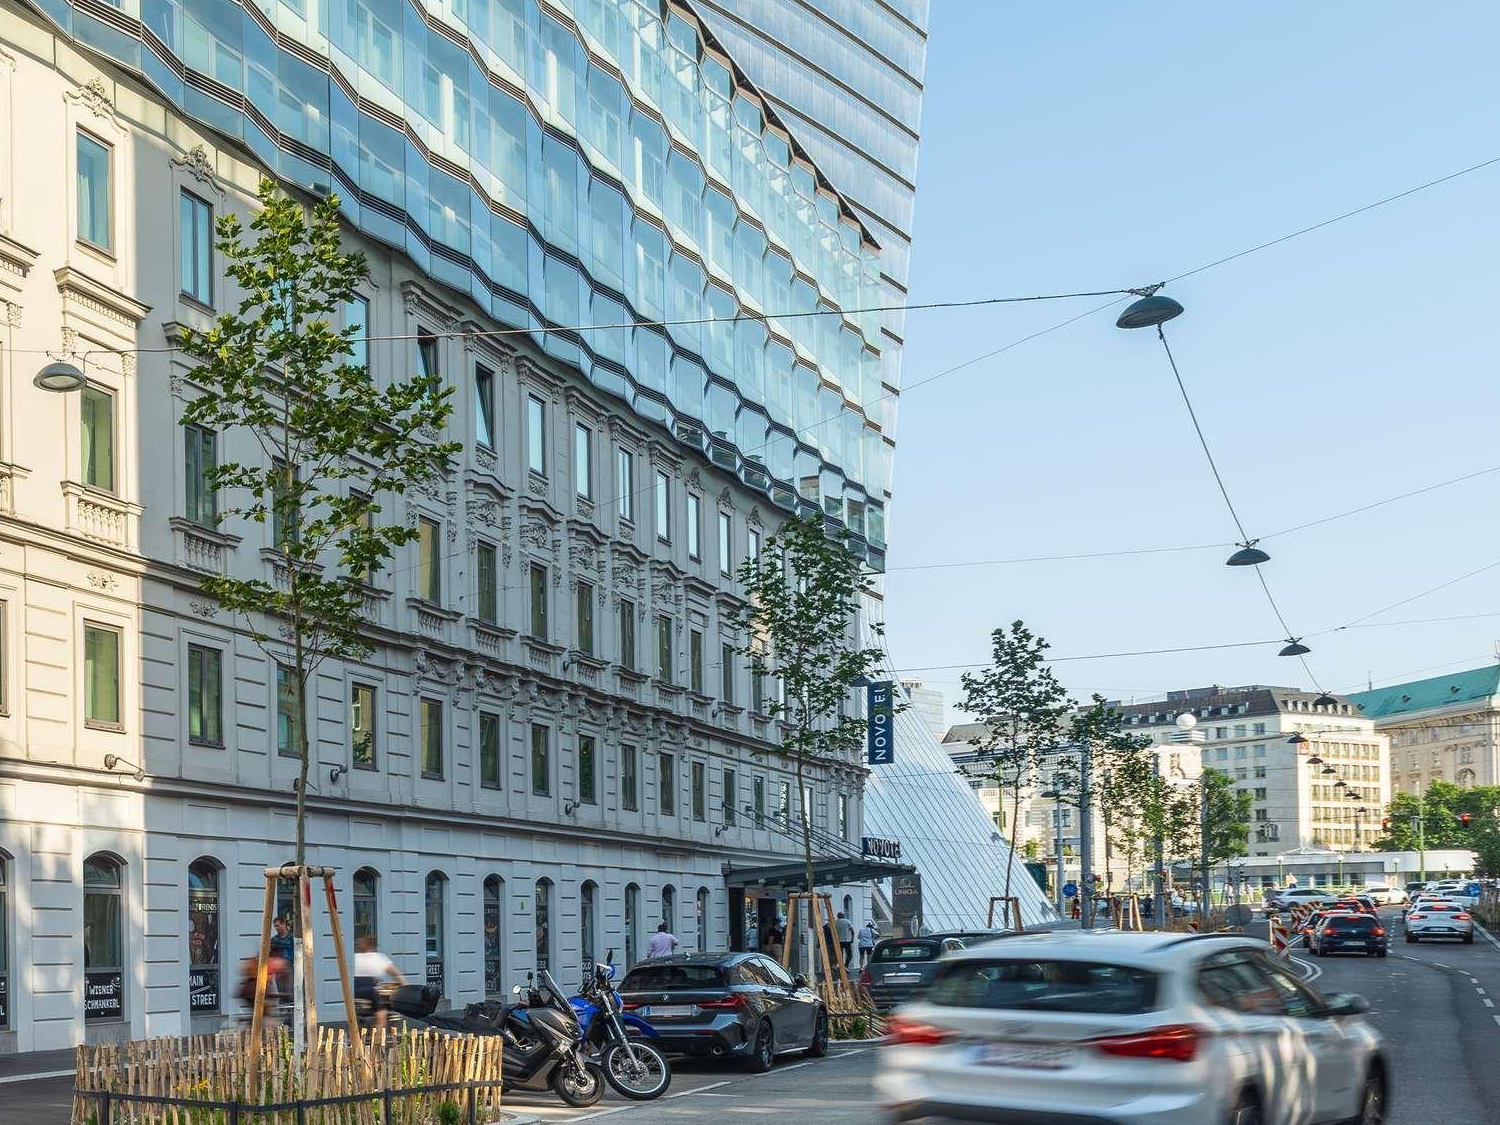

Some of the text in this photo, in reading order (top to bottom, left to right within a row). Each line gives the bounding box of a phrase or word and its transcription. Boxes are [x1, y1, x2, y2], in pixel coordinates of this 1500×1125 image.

[874, 687, 887, 761] NOVOEL
[88, 984, 114, 995] WIENER
[84, 998, 120, 1011] SCHMANKERL
[192, 994, 217, 1006] STREET
